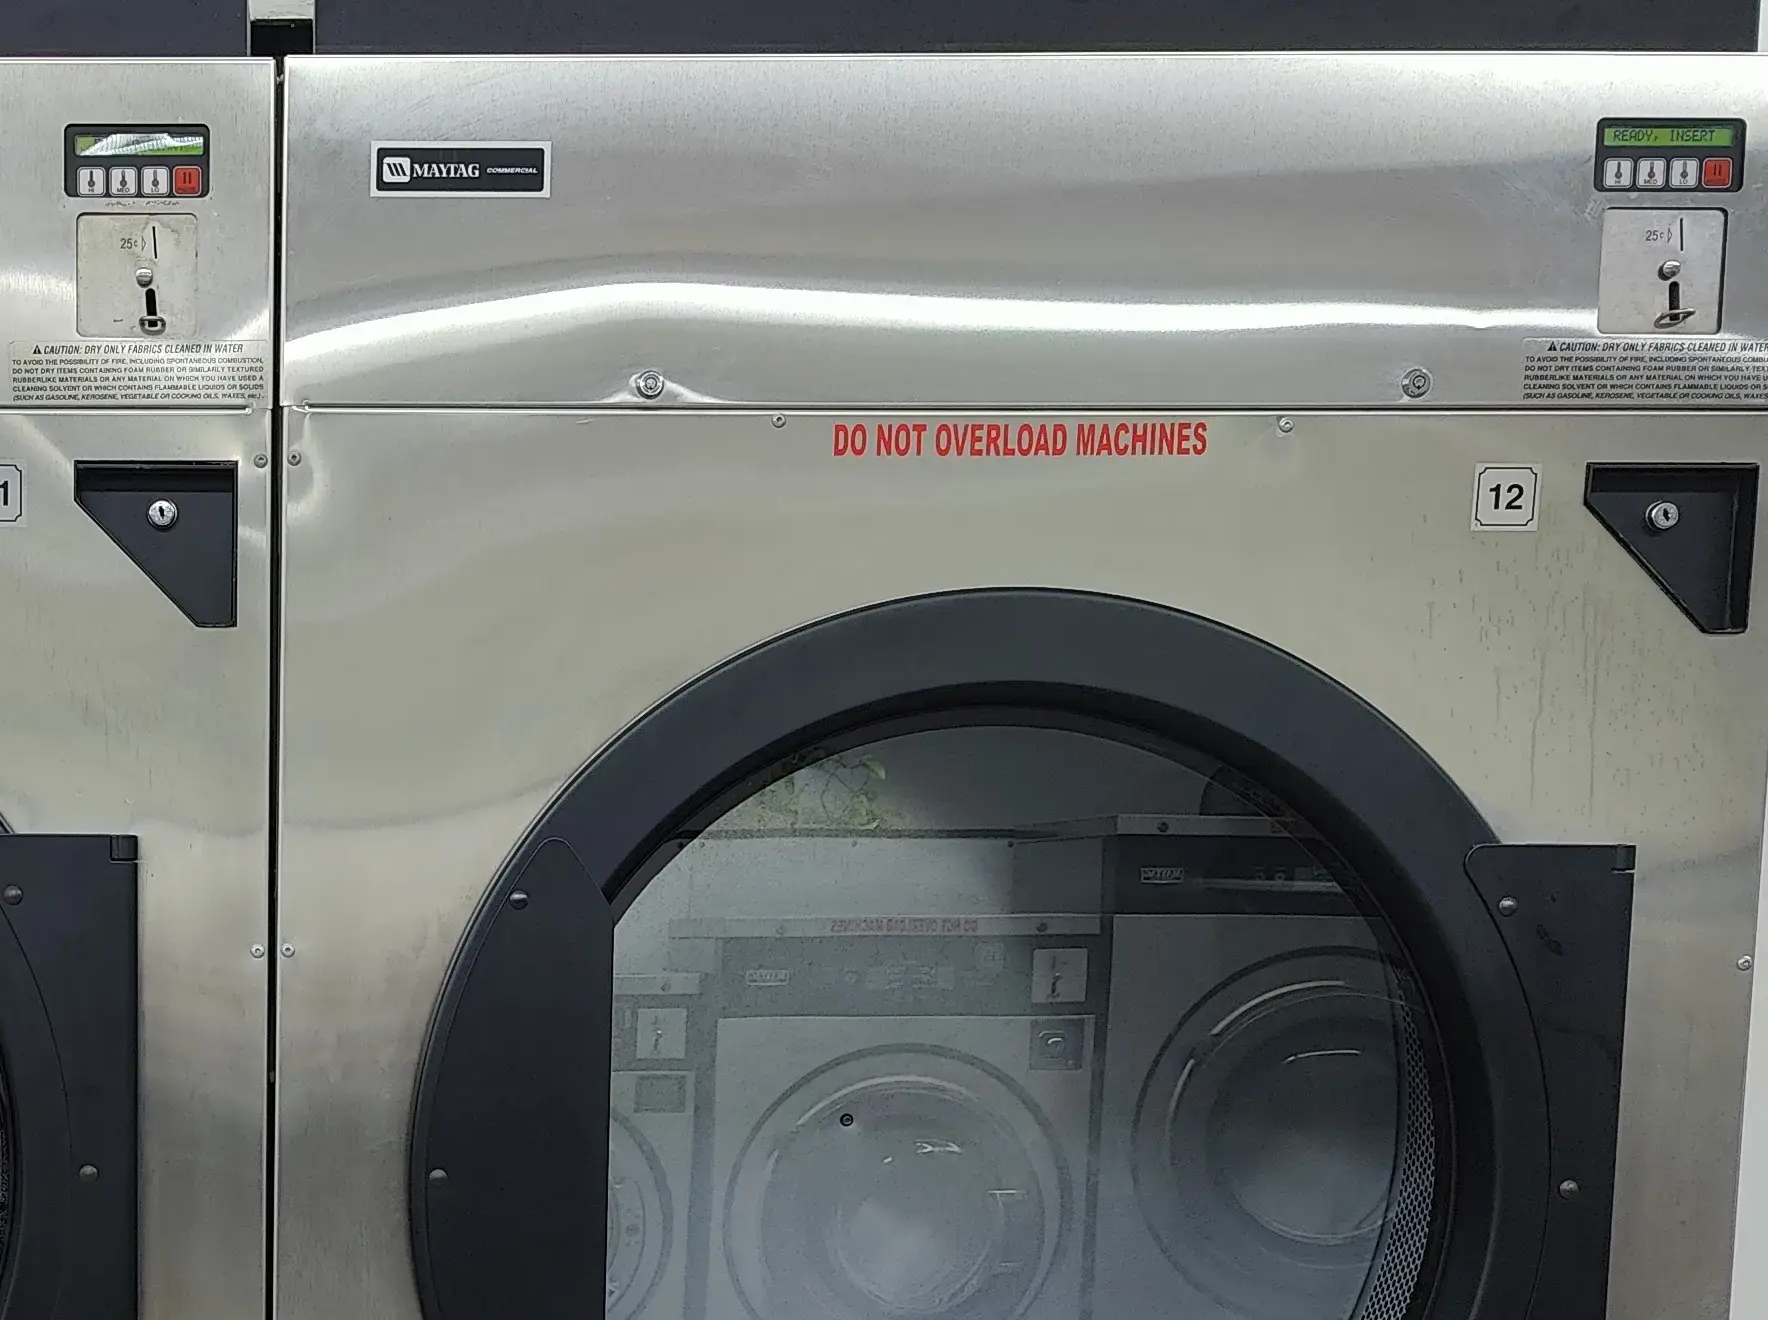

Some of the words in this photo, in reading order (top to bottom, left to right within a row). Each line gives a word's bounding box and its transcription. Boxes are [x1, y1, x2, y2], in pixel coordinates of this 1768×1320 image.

[1670, 129, 1715, 142] INSERT
[413, 163, 479, 178] MAYTAG
[43, 344, 83, 354] CAUTION:
[84, 344, 101, 354] DRY
[104, 344, 126, 354] ONLY
[128, 344, 162, 354] FABRICS
[164, 344, 201, 353] CLEANED
[203, 344, 213, 353] IN
[214, 344, 243, 353] WATER
[1560, 342, 1600, 352] CAUTION:
[1602, 342, 1621, 352] DRY
[1623, 342, 1648, 352] ONLY
[1648, 342, 1685, 352] FABRICS
[1687, 342, 1726, 352] CLEANED
[1728, 342, 1738, 352] IN
[833, 423, 866, 456] DO
[875, 423, 927, 456] NOT
[935, 423, 1068, 456] OVERLOAD
[1076, 422, 1208, 456] MACHINES
[1489, 483, 1524, 510] 12
